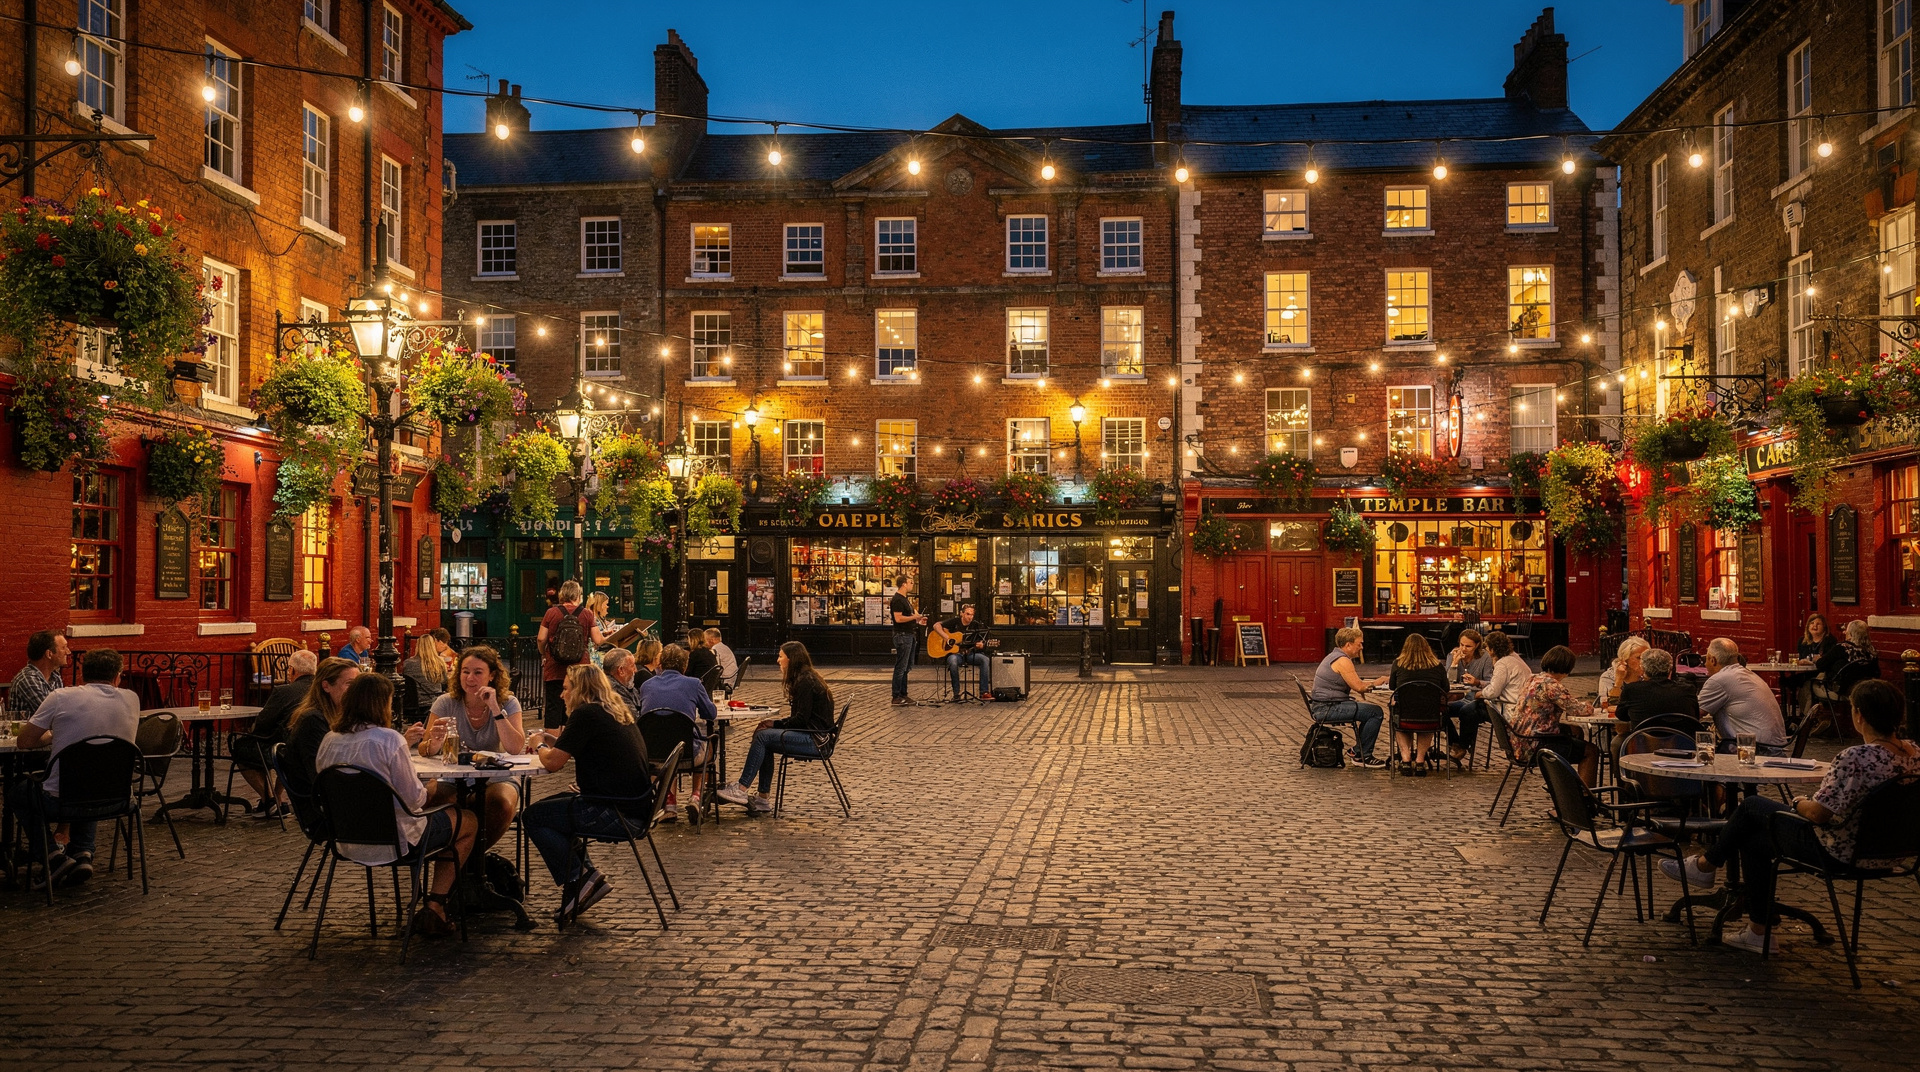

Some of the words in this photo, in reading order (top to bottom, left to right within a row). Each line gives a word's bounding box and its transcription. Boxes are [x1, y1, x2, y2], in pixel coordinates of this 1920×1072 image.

[1360, 498, 1448, 512] TEMPLE
[1462, 498, 1505, 512] BAR
[1003, 513, 1082, 528] SARICS
